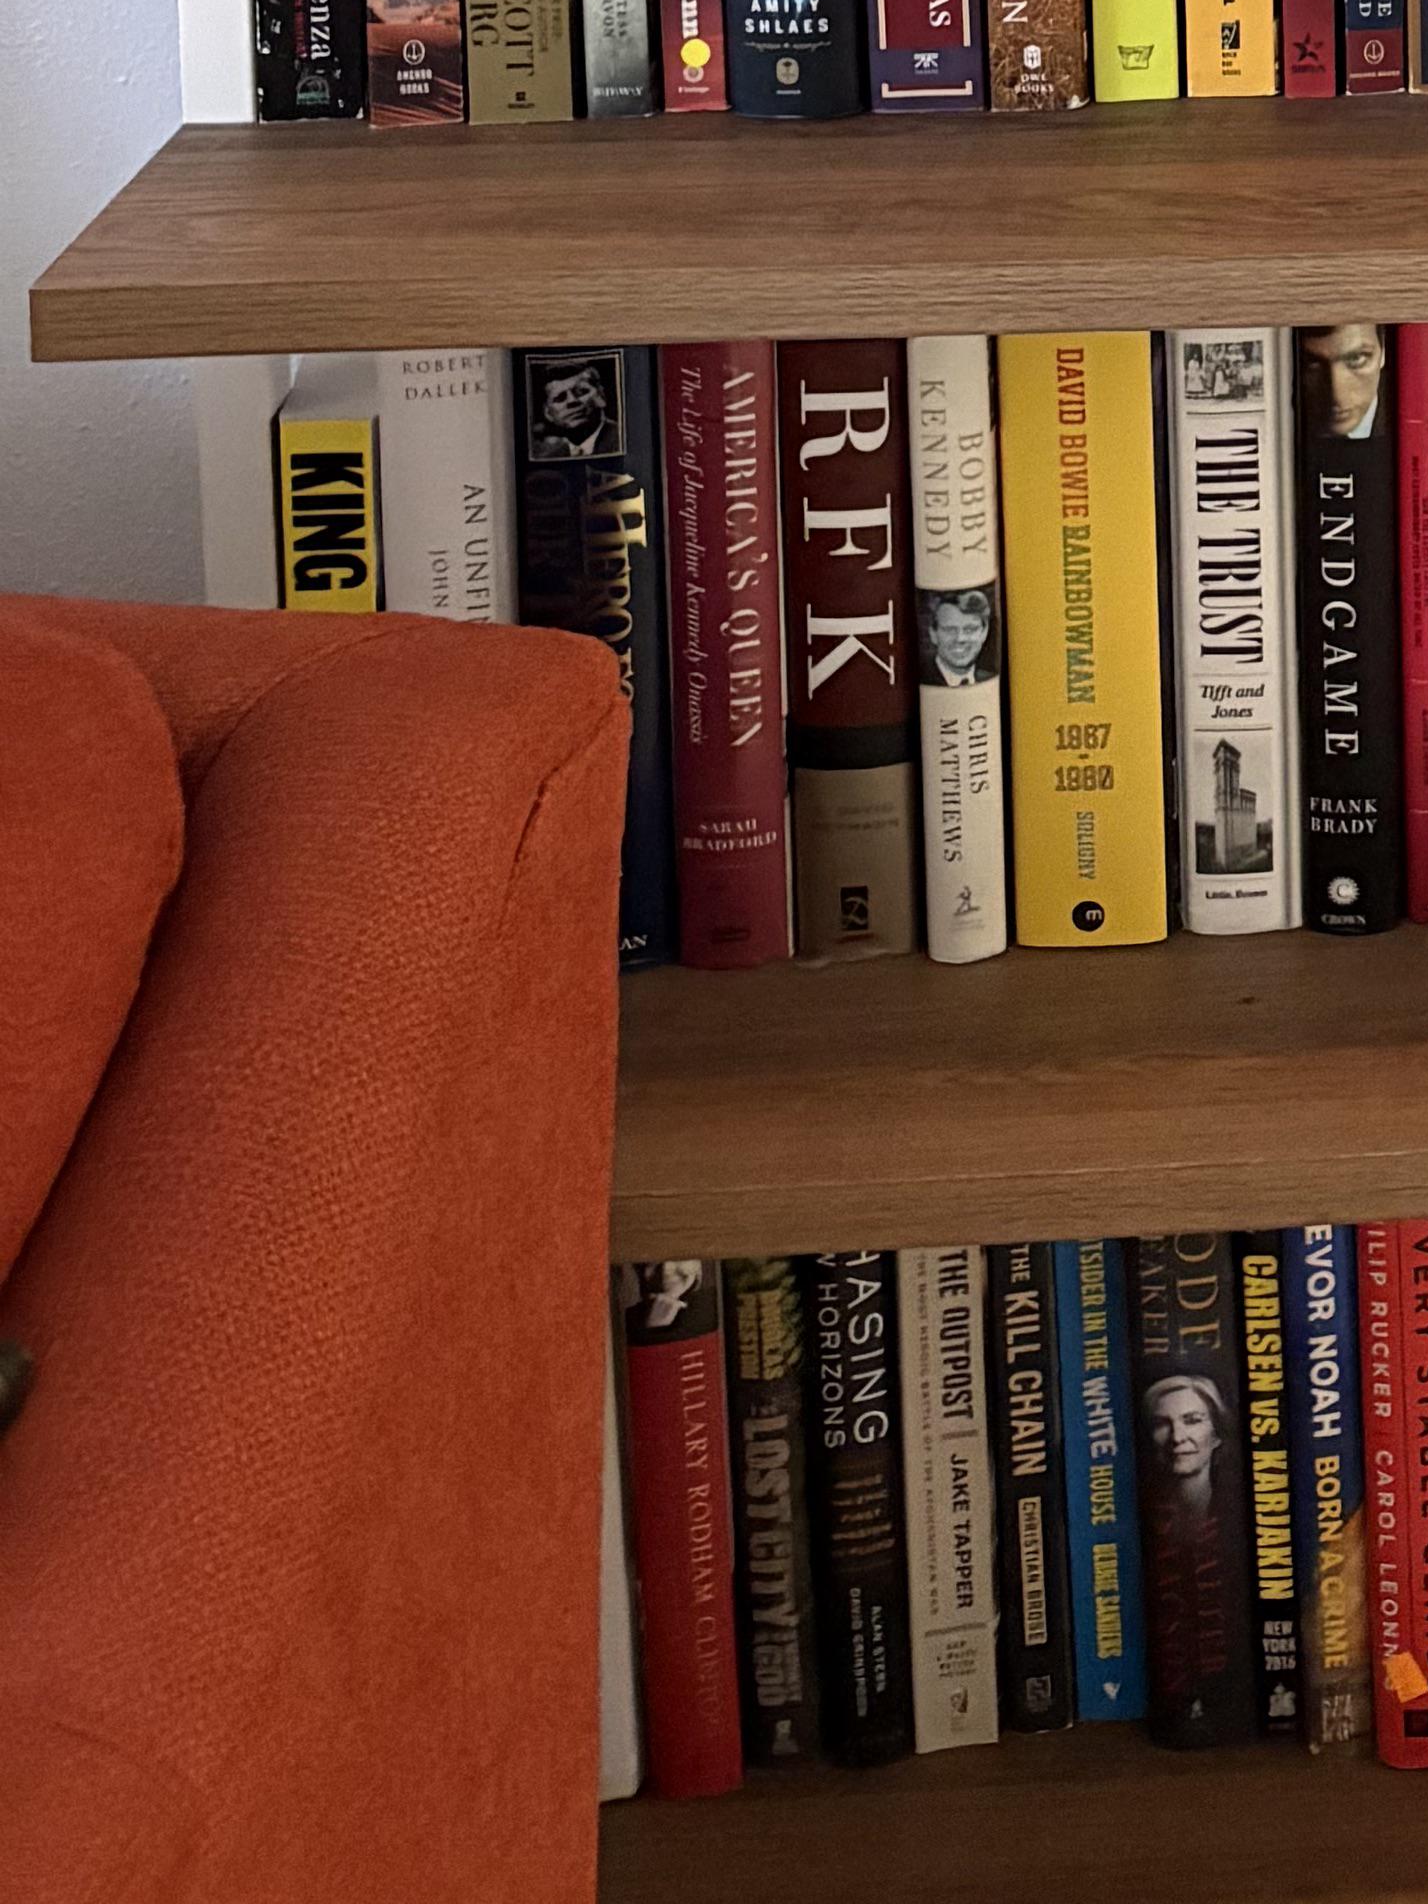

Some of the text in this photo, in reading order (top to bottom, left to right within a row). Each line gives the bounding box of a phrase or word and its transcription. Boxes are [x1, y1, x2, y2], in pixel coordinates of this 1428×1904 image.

[744, 17, 829, 34] SHLAES
[290, 452, 368, 591] KING
[799, 378, 894, 700] RFK
[1319, 472, 1360, 757] ENDGAME
[1310, 797, 1378, 814] FRANK
[1311, 817, 1378, 834] BRADY
[1242, 1254, 1294, 1600] CARLSEN VS. KARJAKIN
[952, 1520, 973, 1610] TAPPER
